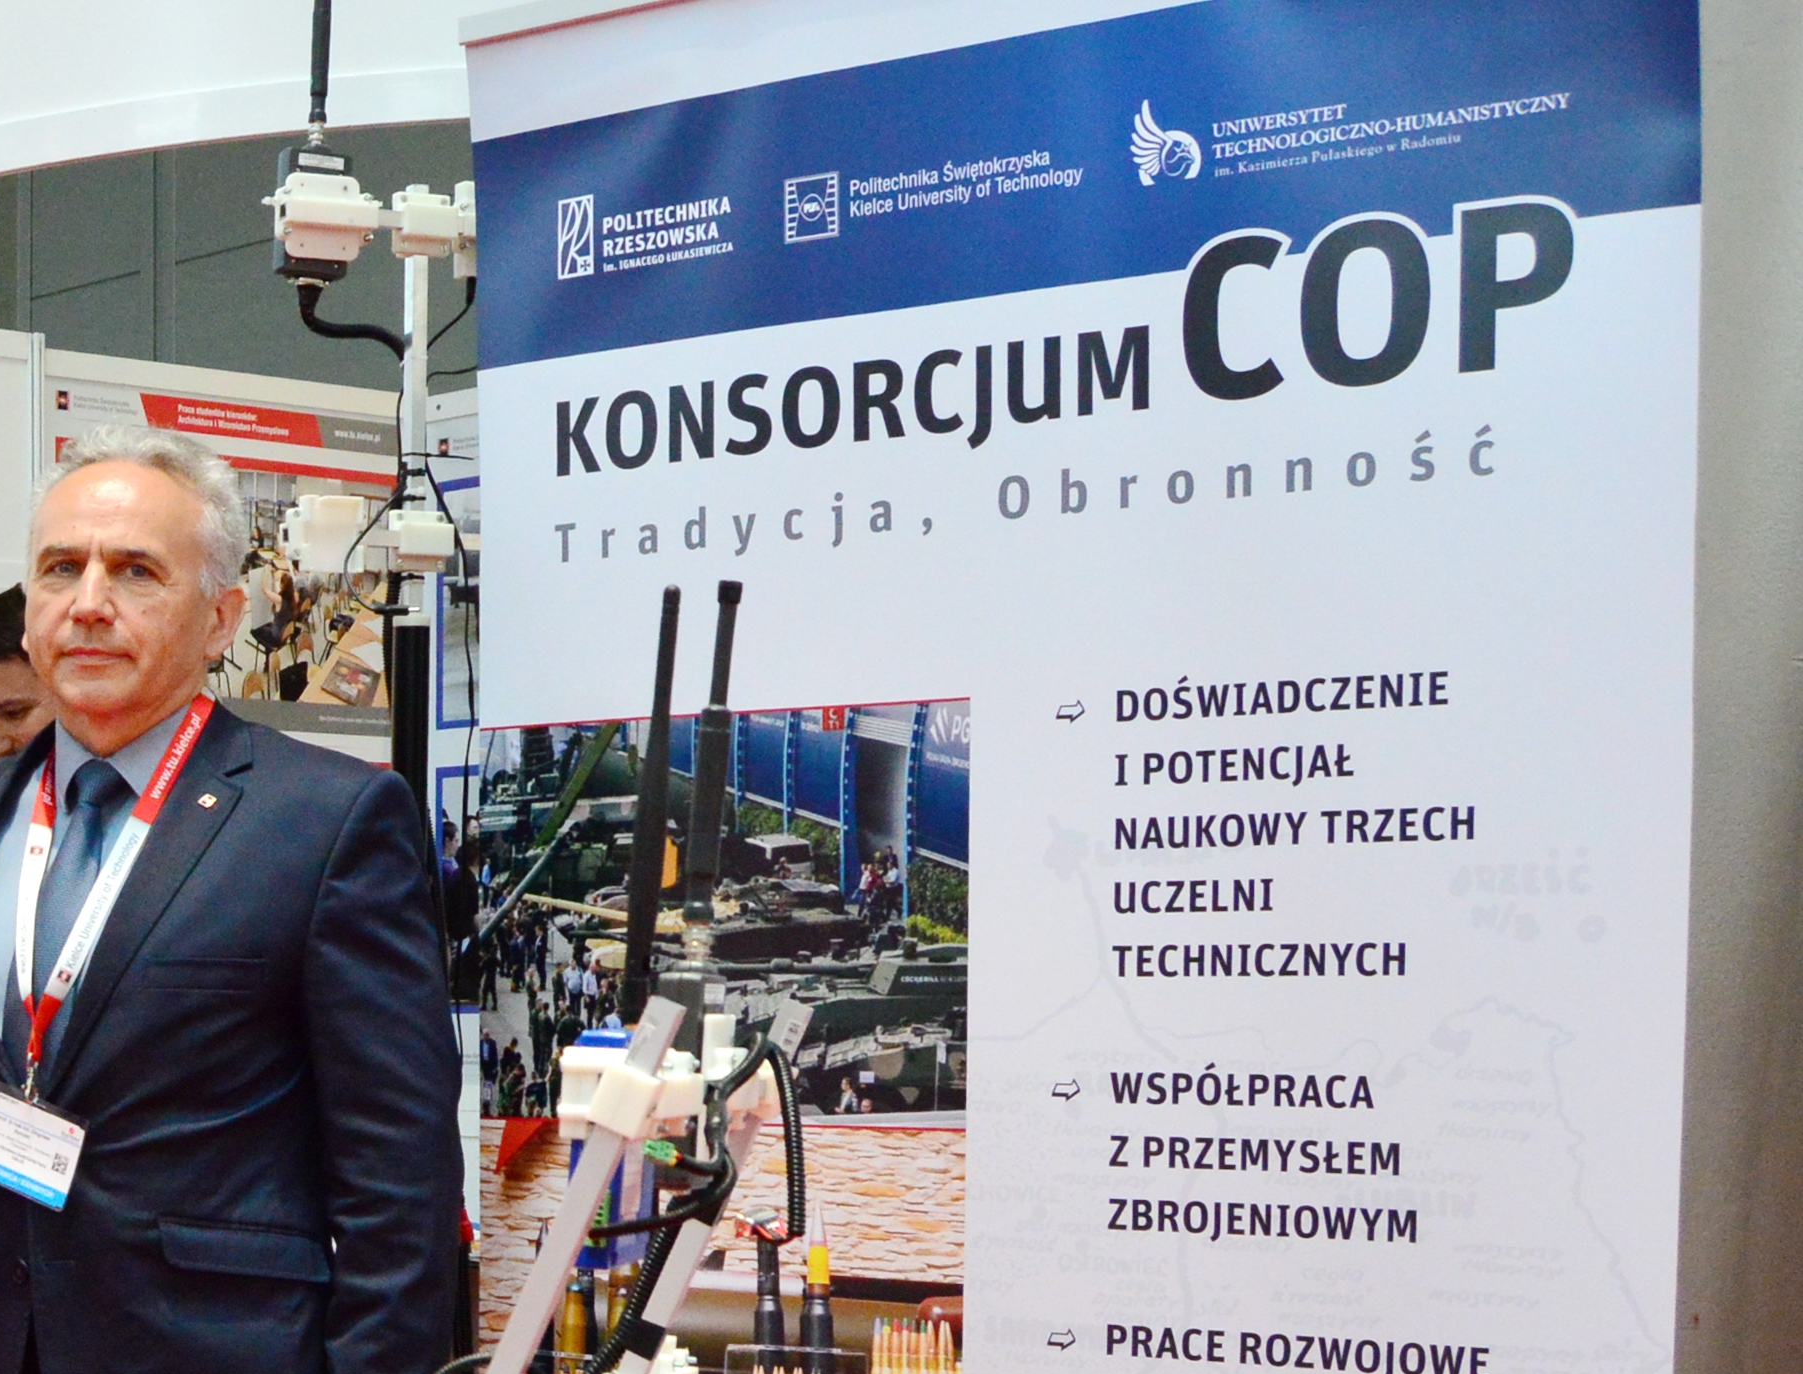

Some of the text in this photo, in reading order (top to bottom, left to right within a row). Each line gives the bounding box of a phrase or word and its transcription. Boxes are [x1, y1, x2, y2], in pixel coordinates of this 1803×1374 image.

[1212, 104, 1347, 138] UNIWERSYTET
[1212, 92, 1571, 160] TECHNOLOGICZNO-HUMANISTYCZNY
[849, 150, 1051, 198] Politechnika Świętokrzyska
[1214, 132, 1461, 178] im. Kazimierza Pułaskiego w Radomiu
[849, 166, 1084, 218] Kielce University of Technology
[602, 196, 731, 236] POLITECHNIKA
[602, 221, 719, 258] RZESZOWSKA
[619, 252, 664, 271] IGNACEGO
[666, 242, 734, 264] ŁUKASIEWICZA
[555, 201, 1575, 477] KONSORCJUM COP
[555, 423, 1498, 564] Tradycja, Obronność
[1115, 671, 1449, 722] DOŚWIADCZENIE
[149, 713, 202, 801] www.tu.kielce.pl
[1114, 744, 1354, 787] I POTENCJAŁ
[1114, 806, 1476, 850] NAUKOWY TRZECH
[1113, 878, 1274, 914] UCZELNI
[66, 940, 85, 970] Kielce
[1112, 942, 1406, 978] TECHNICZNYCH
[1110, 1062, 1375, 1109] WSPÓŁPRACA
[1109, 1136, 1401, 1176] Z PRZEMYSŁEM
[1108, 1198, 1418, 1243] ZBROJENIOWYM
[1106, 1324, 1226, 1363] PRACE
